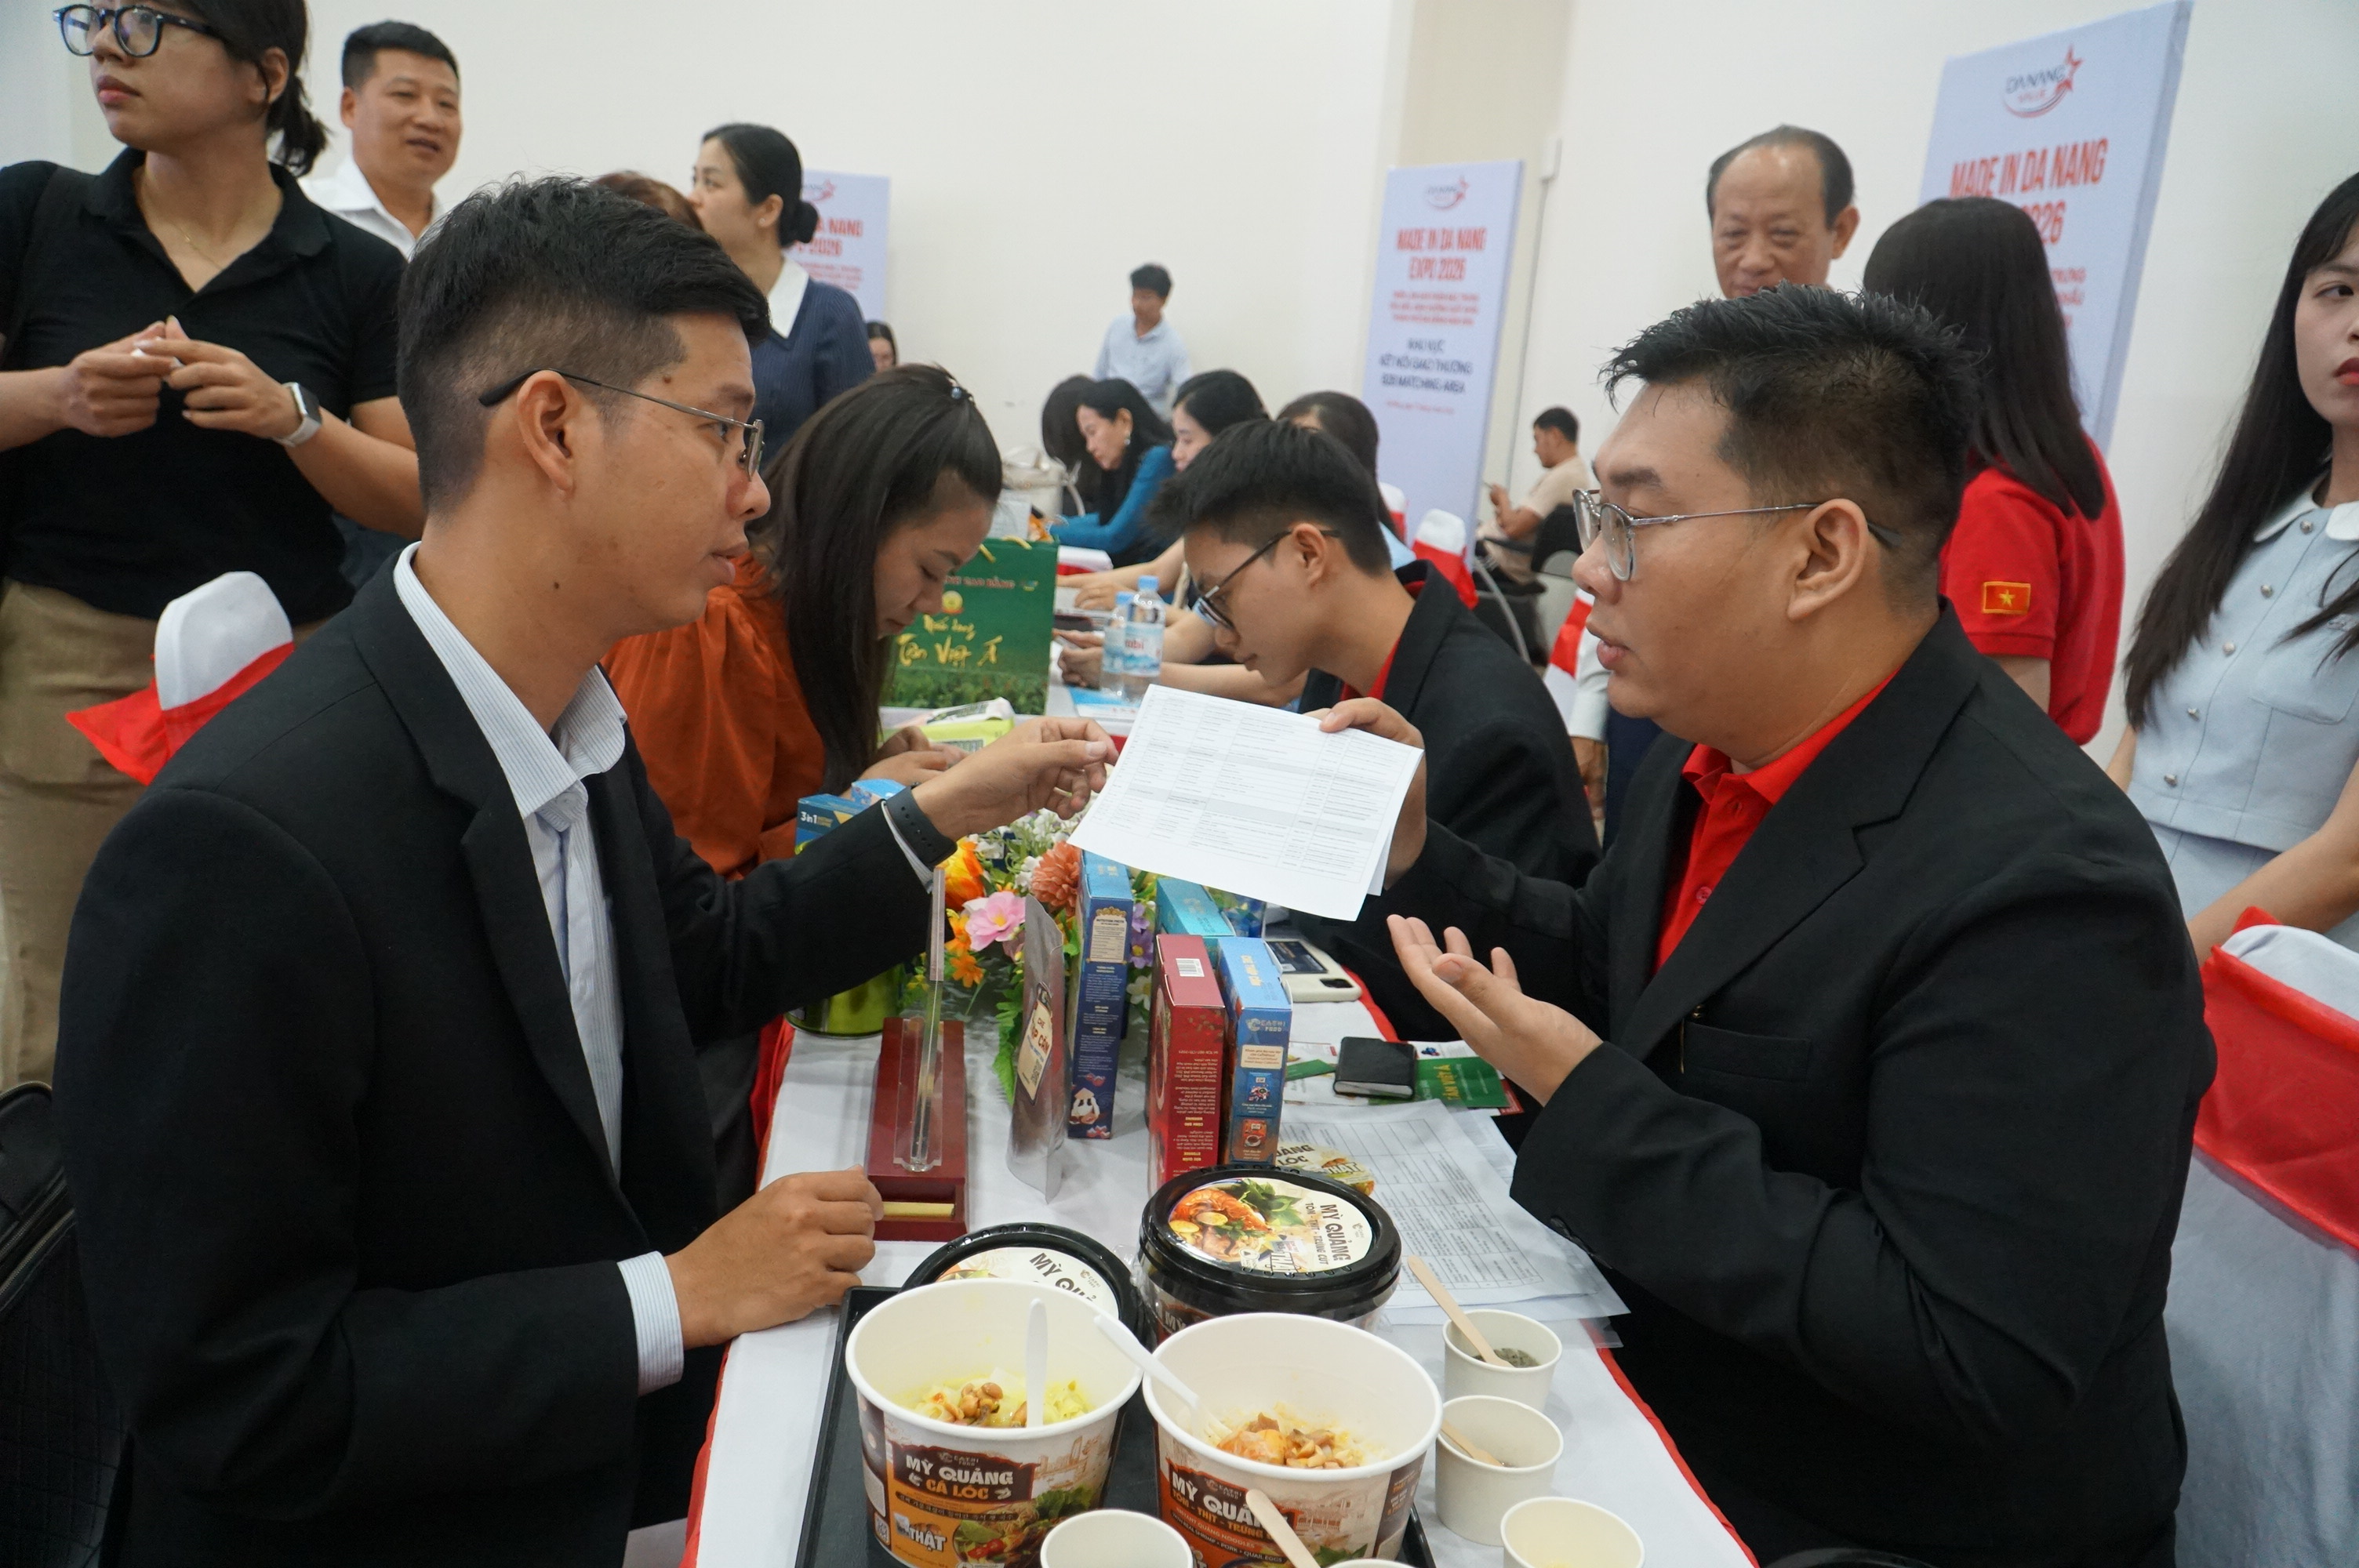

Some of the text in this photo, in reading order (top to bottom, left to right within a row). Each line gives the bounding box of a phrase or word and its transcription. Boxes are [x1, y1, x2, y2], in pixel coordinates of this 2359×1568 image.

[1950, 137, 2108, 198] MADE IN DA NANG
[1397, 226, 1487, 250] MADE IN DA NANG
[2022, 200, 2066, 245] 26
[1409, 256, 1436, 280] EXPO
[1320, 1204, 1353, 1261] MỲ QUẢNG
[1030, 1253, 1063, 1277] MỲ
[906, 1454, 1013, 1485] MỲ QUẢNG
[925, 1477, 989, 1500] CÁ LÓC
[1172, 1472, 1264, 1528] MỲ QUẢ
[1172, 1490, 1190, 1508] TÔM
[1197, 1508, 1218, 1524] THỊT
[1227, 1522, 1263, 1538] TRỨNG
[909, 1528, 947, 1552] THẬT
[1176, 1507, 1198, 1525] INSTANT
[1221, 1534, 1255, 1549] NOODLES
[1183, 1521, 1195, 1534] REAL
[1194, 1530, 1216, 1544] SHRIMP
[1220, 1543, 1238, 1553] PORK
[1244, 1550, 1263, 1561] QUAIL
[1265, 1555, 1283, 1563] EGGS
